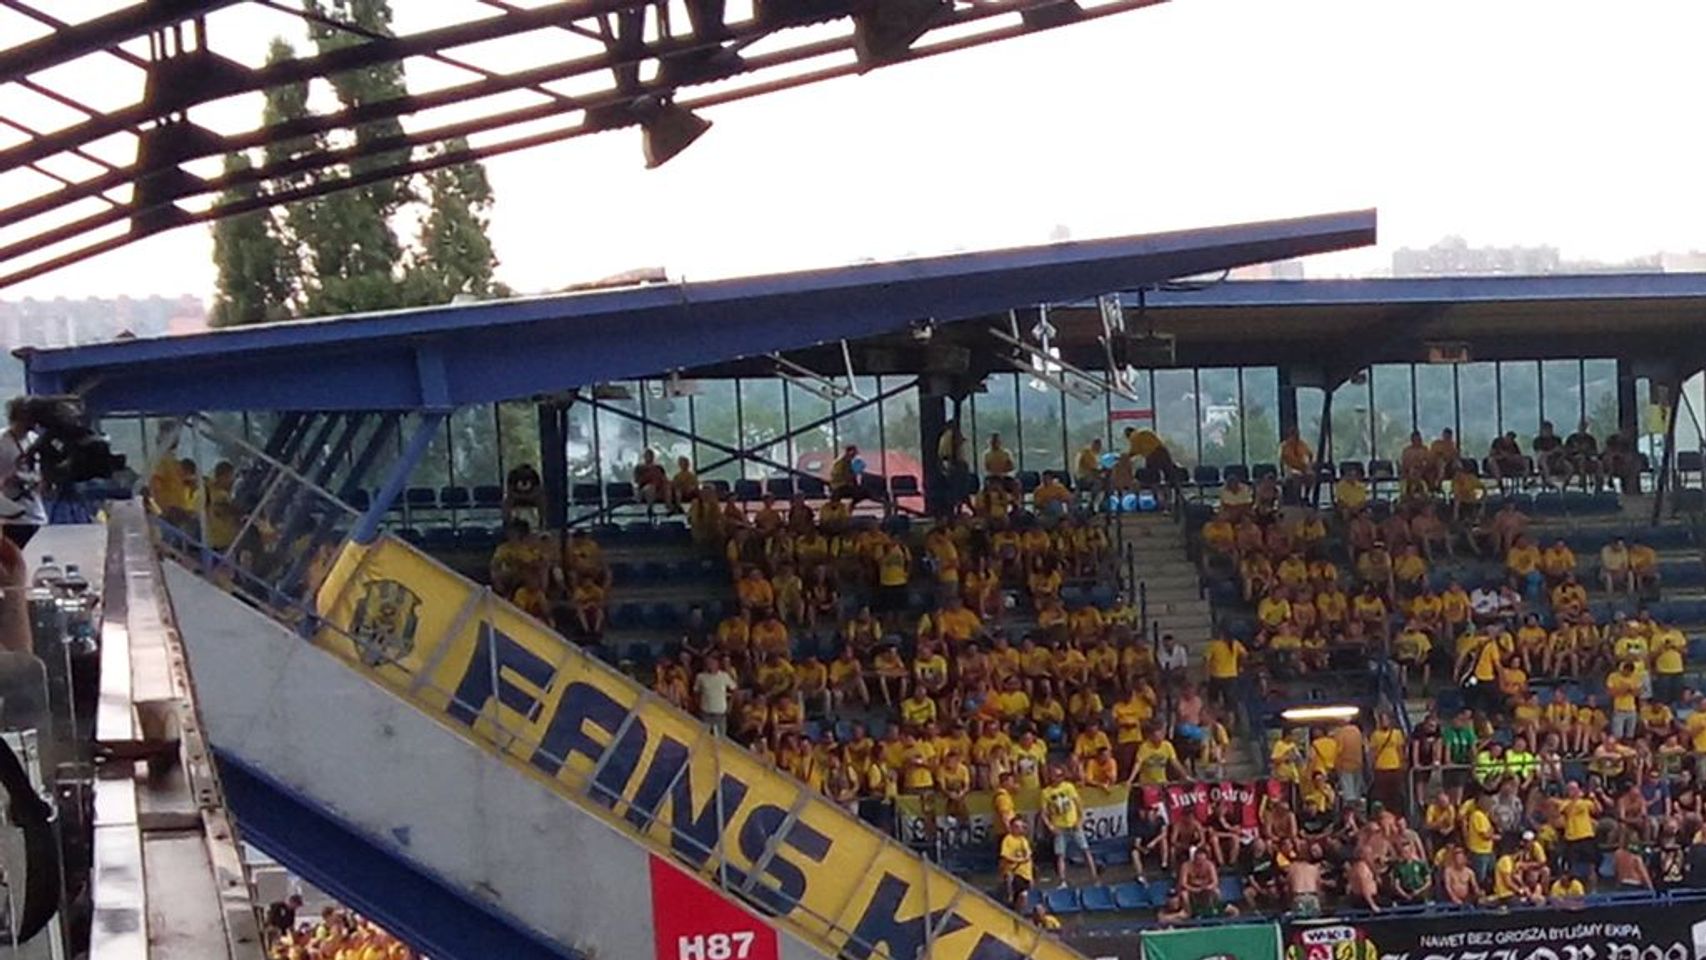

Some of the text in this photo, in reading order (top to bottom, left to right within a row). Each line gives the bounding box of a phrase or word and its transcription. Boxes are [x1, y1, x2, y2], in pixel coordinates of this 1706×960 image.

[447, 620, 832, 917] FANS
[1170, 790, 1207, 808] Juve
[1420, 932, 1465, 948] NAWET
[1467, 931, 1493, 945] BEZ
[1495, 929, 1548, 943] GROSZA
